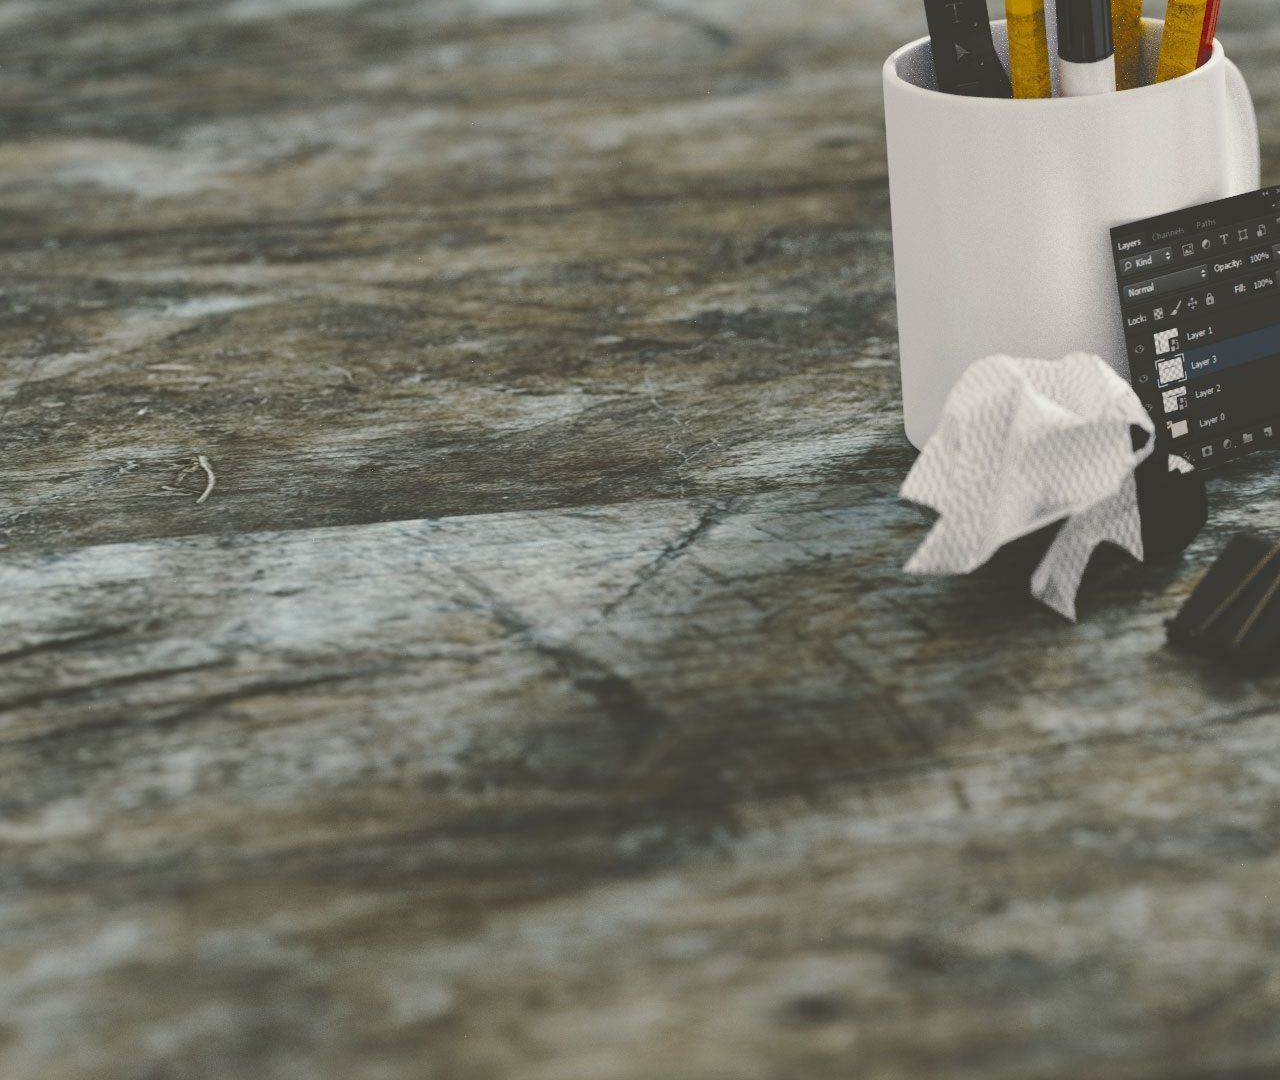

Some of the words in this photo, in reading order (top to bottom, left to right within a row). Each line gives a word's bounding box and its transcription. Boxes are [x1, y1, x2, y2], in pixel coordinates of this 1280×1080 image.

[1117, 237, 1142, 251] Layers
[1151, 226, 1185, 242] Channels
[1196, 217, 1217, 230] Paths
[1135, 255, 1153, 268] Kind
[1213, 258, 1243, 274] Opacity:
[1249, 250, 1270, 264] 100%
[1127, 282, 1155, 298] Normal
[1253, 276, 1273, 290] 100%
[1127, 313, 1147, 326] Lock:
[1186, 327, 1206, 341] Layer
[1190, 356, 1210, 370] Layer
[1195, 385, 1214, 399] Layer
[1199, 414, 1218, 428] Layer
